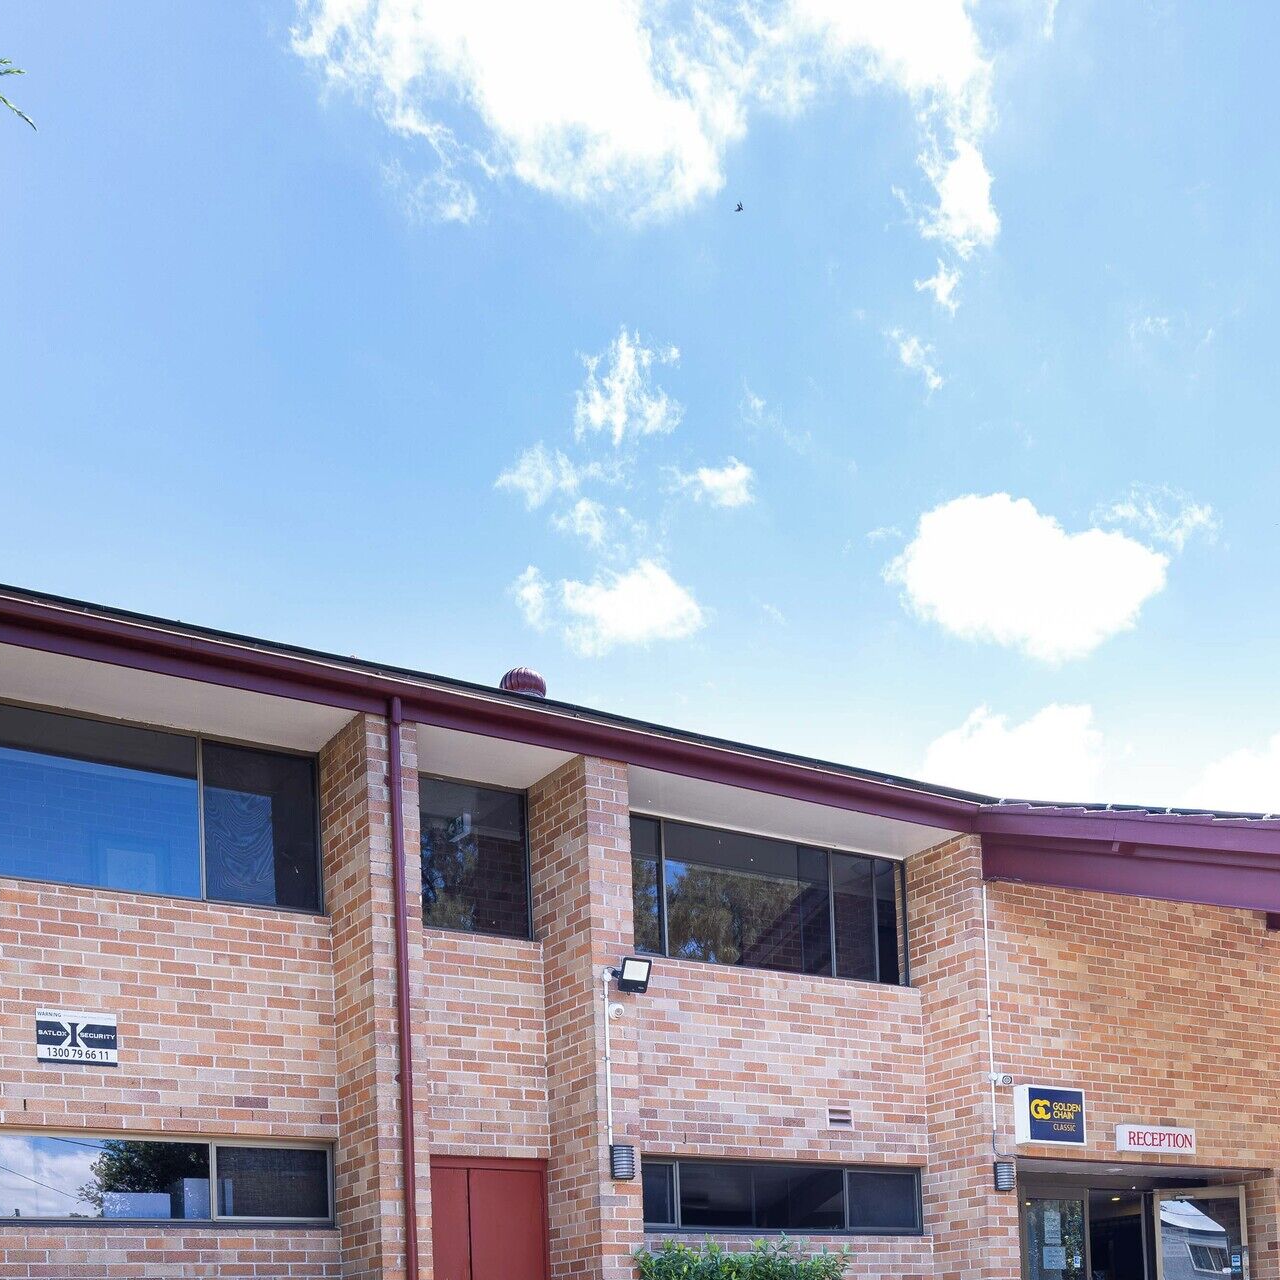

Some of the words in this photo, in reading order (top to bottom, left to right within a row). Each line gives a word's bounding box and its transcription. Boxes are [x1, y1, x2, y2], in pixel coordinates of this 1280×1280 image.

[38, 1029, 67, 1037] SATLOX
[80, 1032, 115, 1040] SECURITY
[47, 1047, 70, 1058] 1300
[72, 1049, 83, 1058] 79
[85, 1050, 96, 1060] 66
[99, 1051, 109, 1060] 11
[1053, 1102, 1081, 1112] GOLDEN
[1053, 1110, 1074, 1120] CHAIN
[1053, 1123, 1076, 1132] CLASSIC
[1128, 1131, 1192, 1148] RECEPTION
